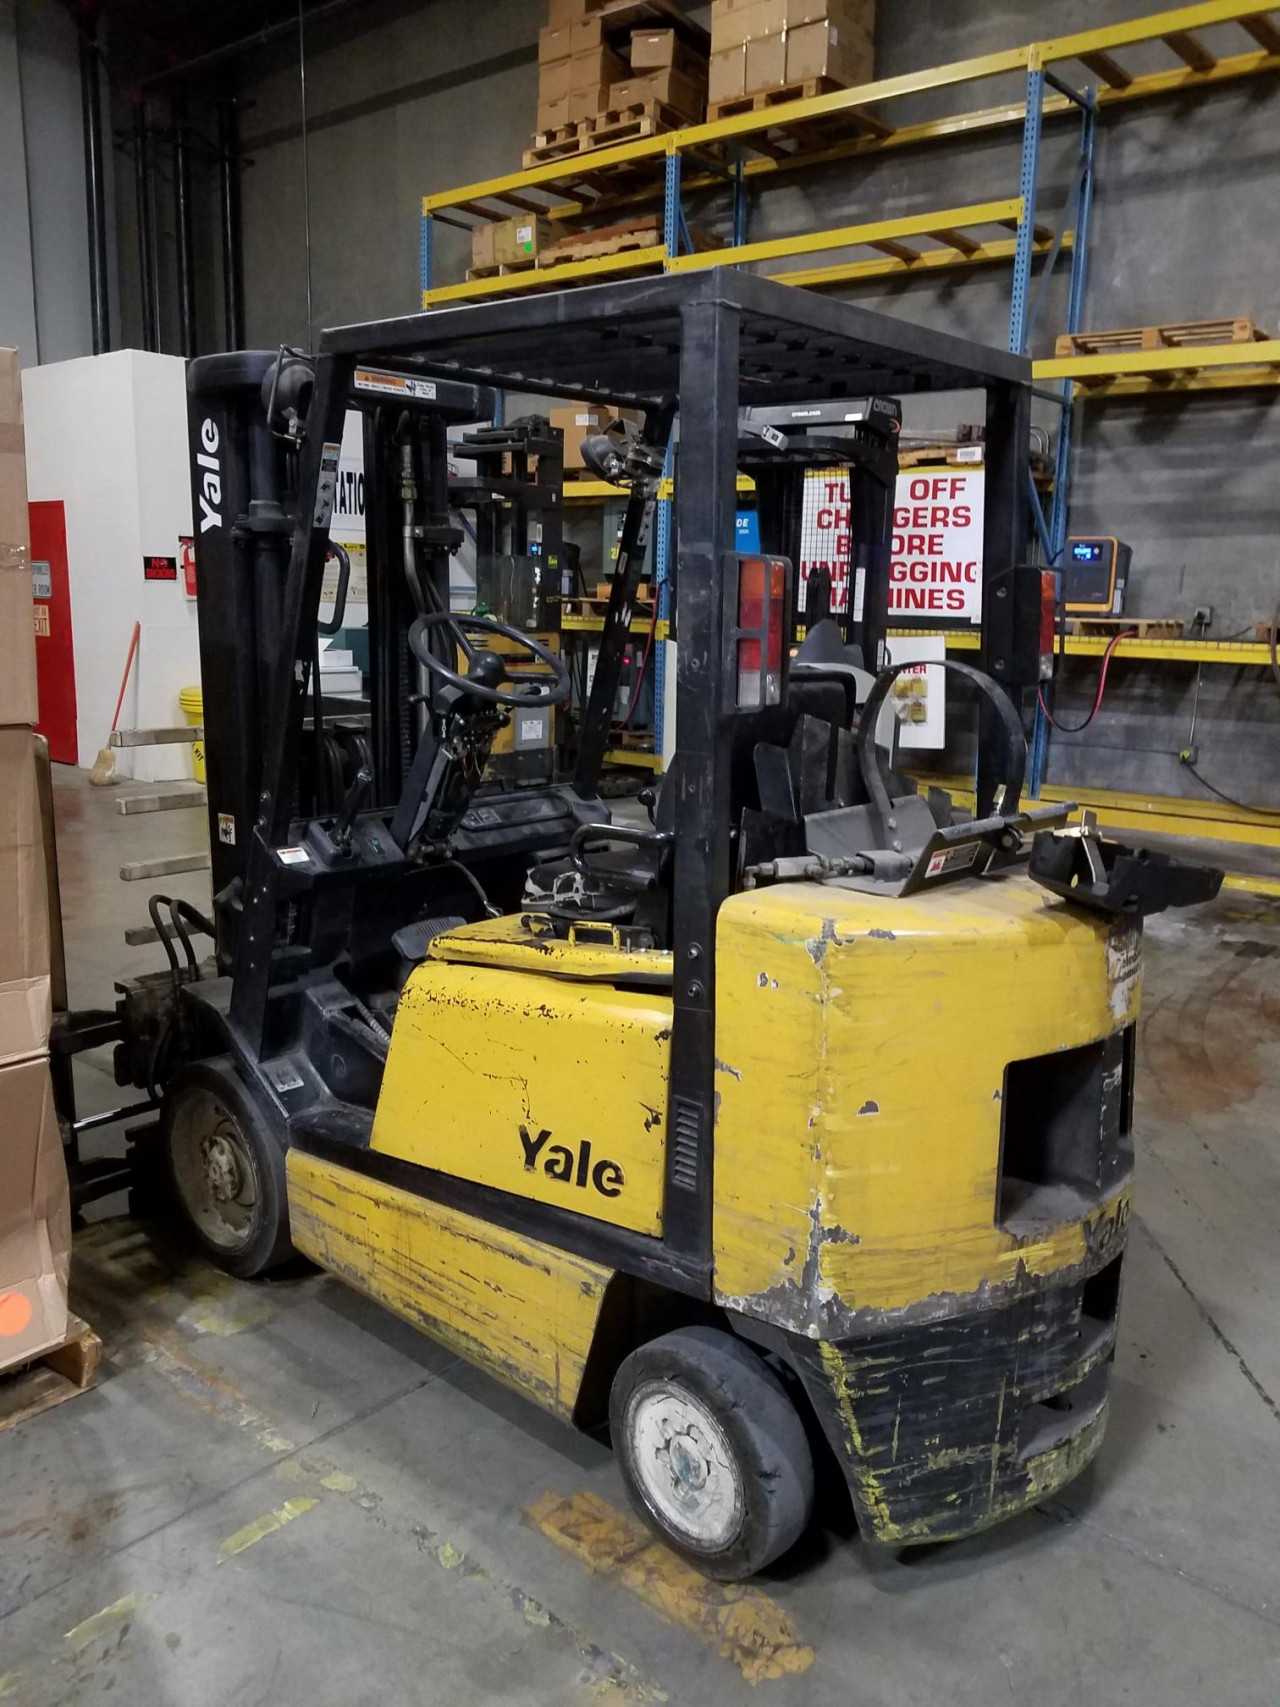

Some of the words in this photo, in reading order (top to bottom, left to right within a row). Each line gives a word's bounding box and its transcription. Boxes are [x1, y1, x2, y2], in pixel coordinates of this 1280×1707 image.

[196, 417, 223, 534] Yale
[909, 477, 967, 501] OFF
[815, 505, 972, 530] CHGERS
[836, 533, 944, 556] BORE
[518, 1124, 625, 1198] Yale
